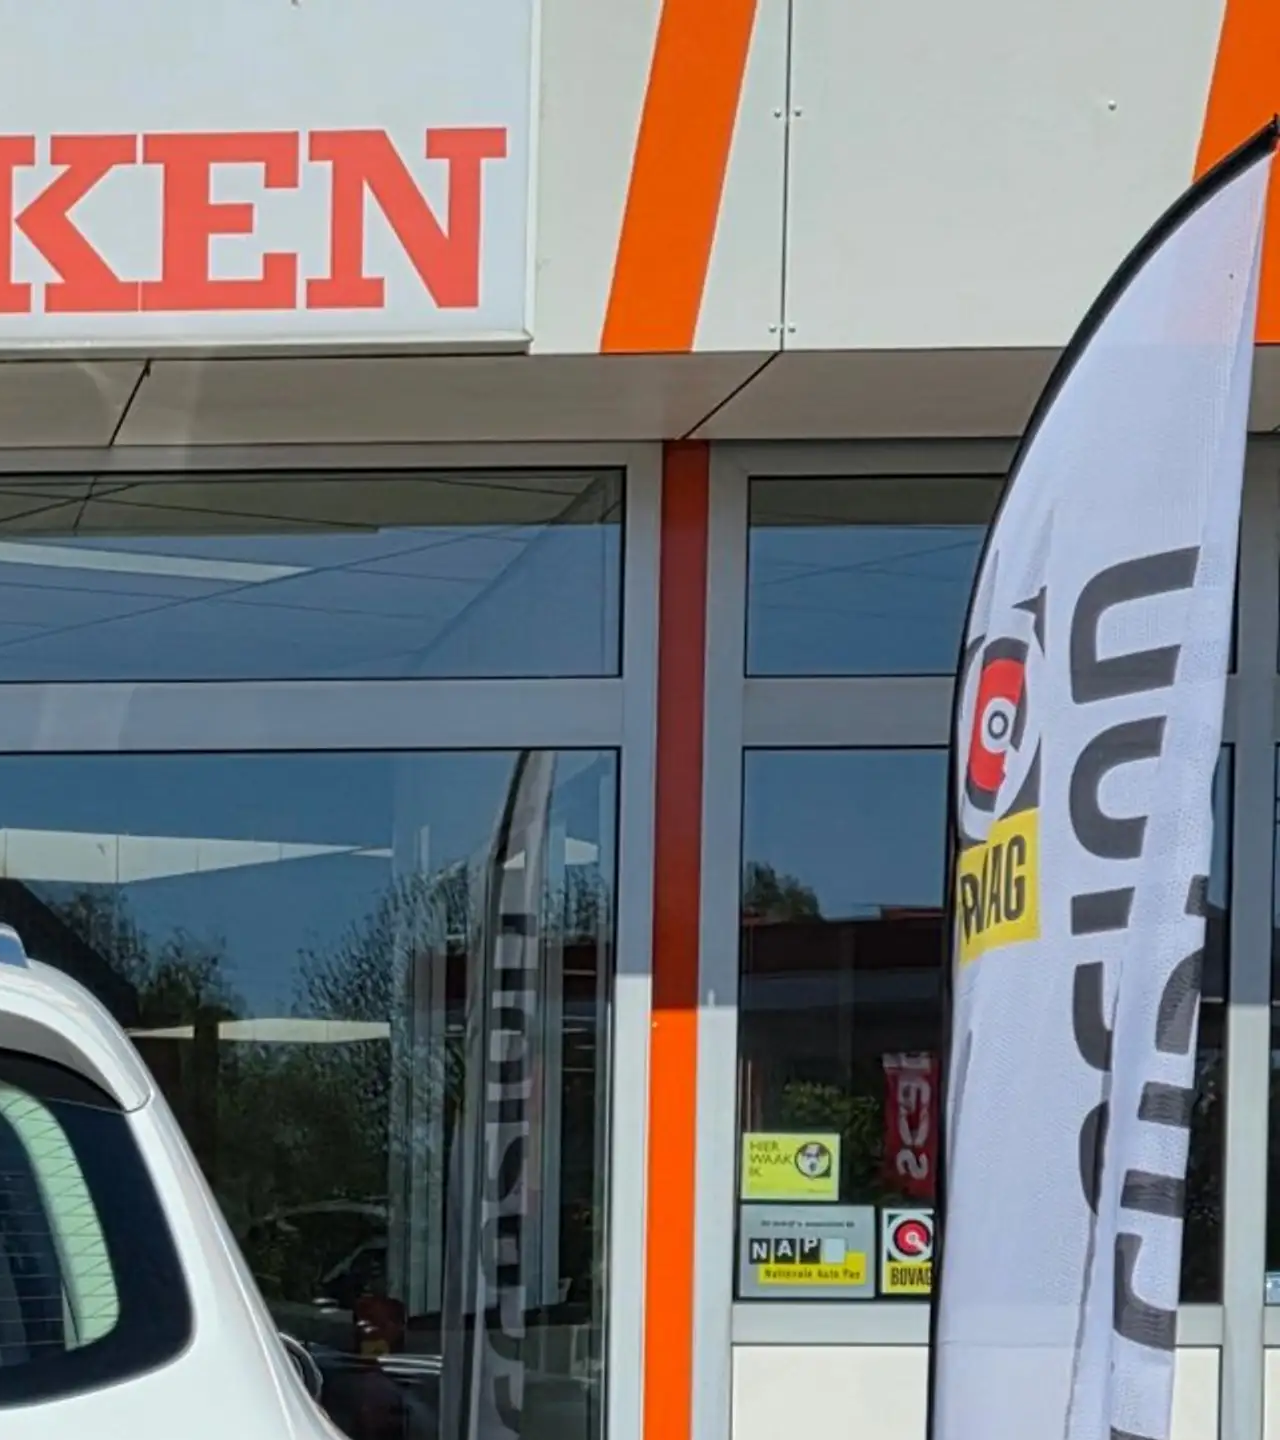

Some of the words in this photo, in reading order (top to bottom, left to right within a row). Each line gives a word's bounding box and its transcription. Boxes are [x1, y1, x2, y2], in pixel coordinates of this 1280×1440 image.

[749, 1140, 780, 1151] HIER
[749, 1153, 793, 1165] WAAK
[751, 1237, 818, 1260] NAP
